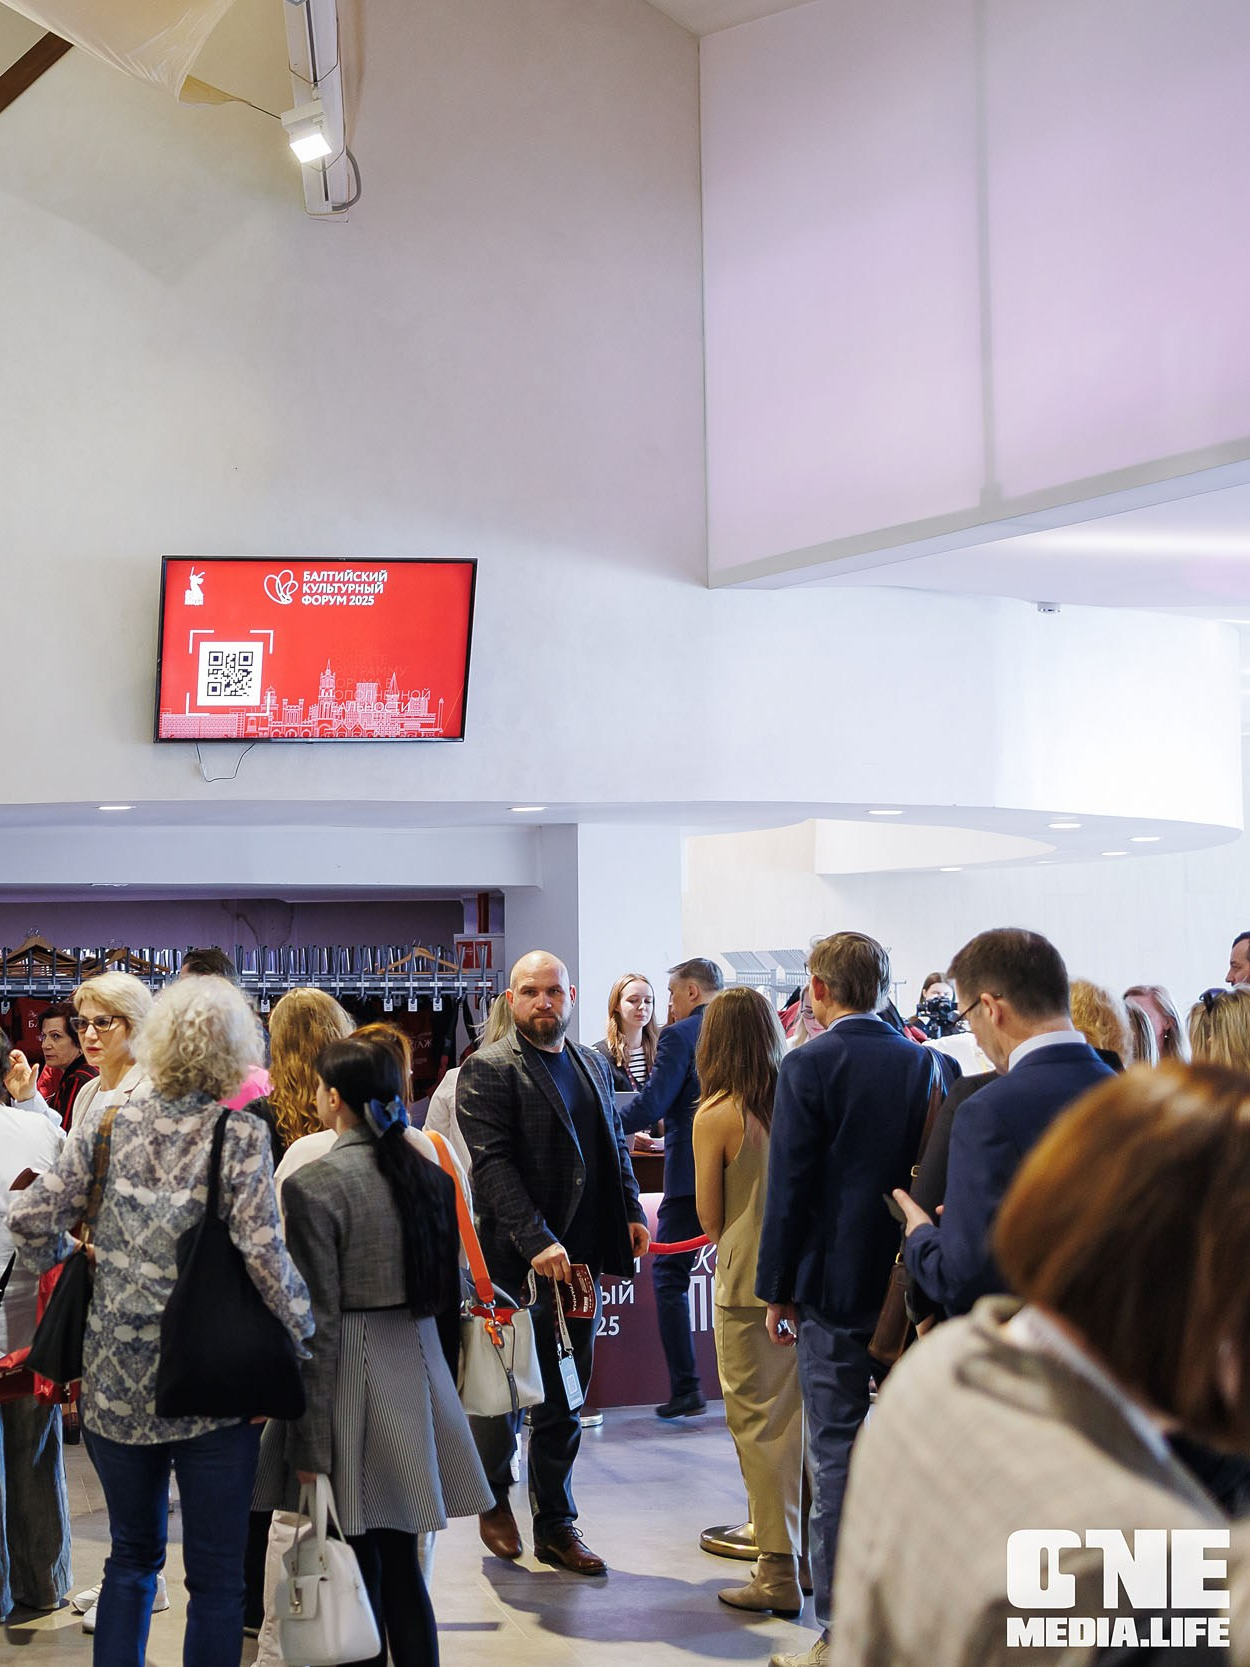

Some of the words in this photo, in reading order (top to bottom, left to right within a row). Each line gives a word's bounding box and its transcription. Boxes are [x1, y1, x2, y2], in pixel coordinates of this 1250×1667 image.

[303, 569, 388, 582] БАЛТИЙСКИЙ
[302, 582, 384, 594] КУЛЬТУРНЫЙ
[301, 595, 347, 606] ФОРУМ
[348, 595, 375, 606] 2025
